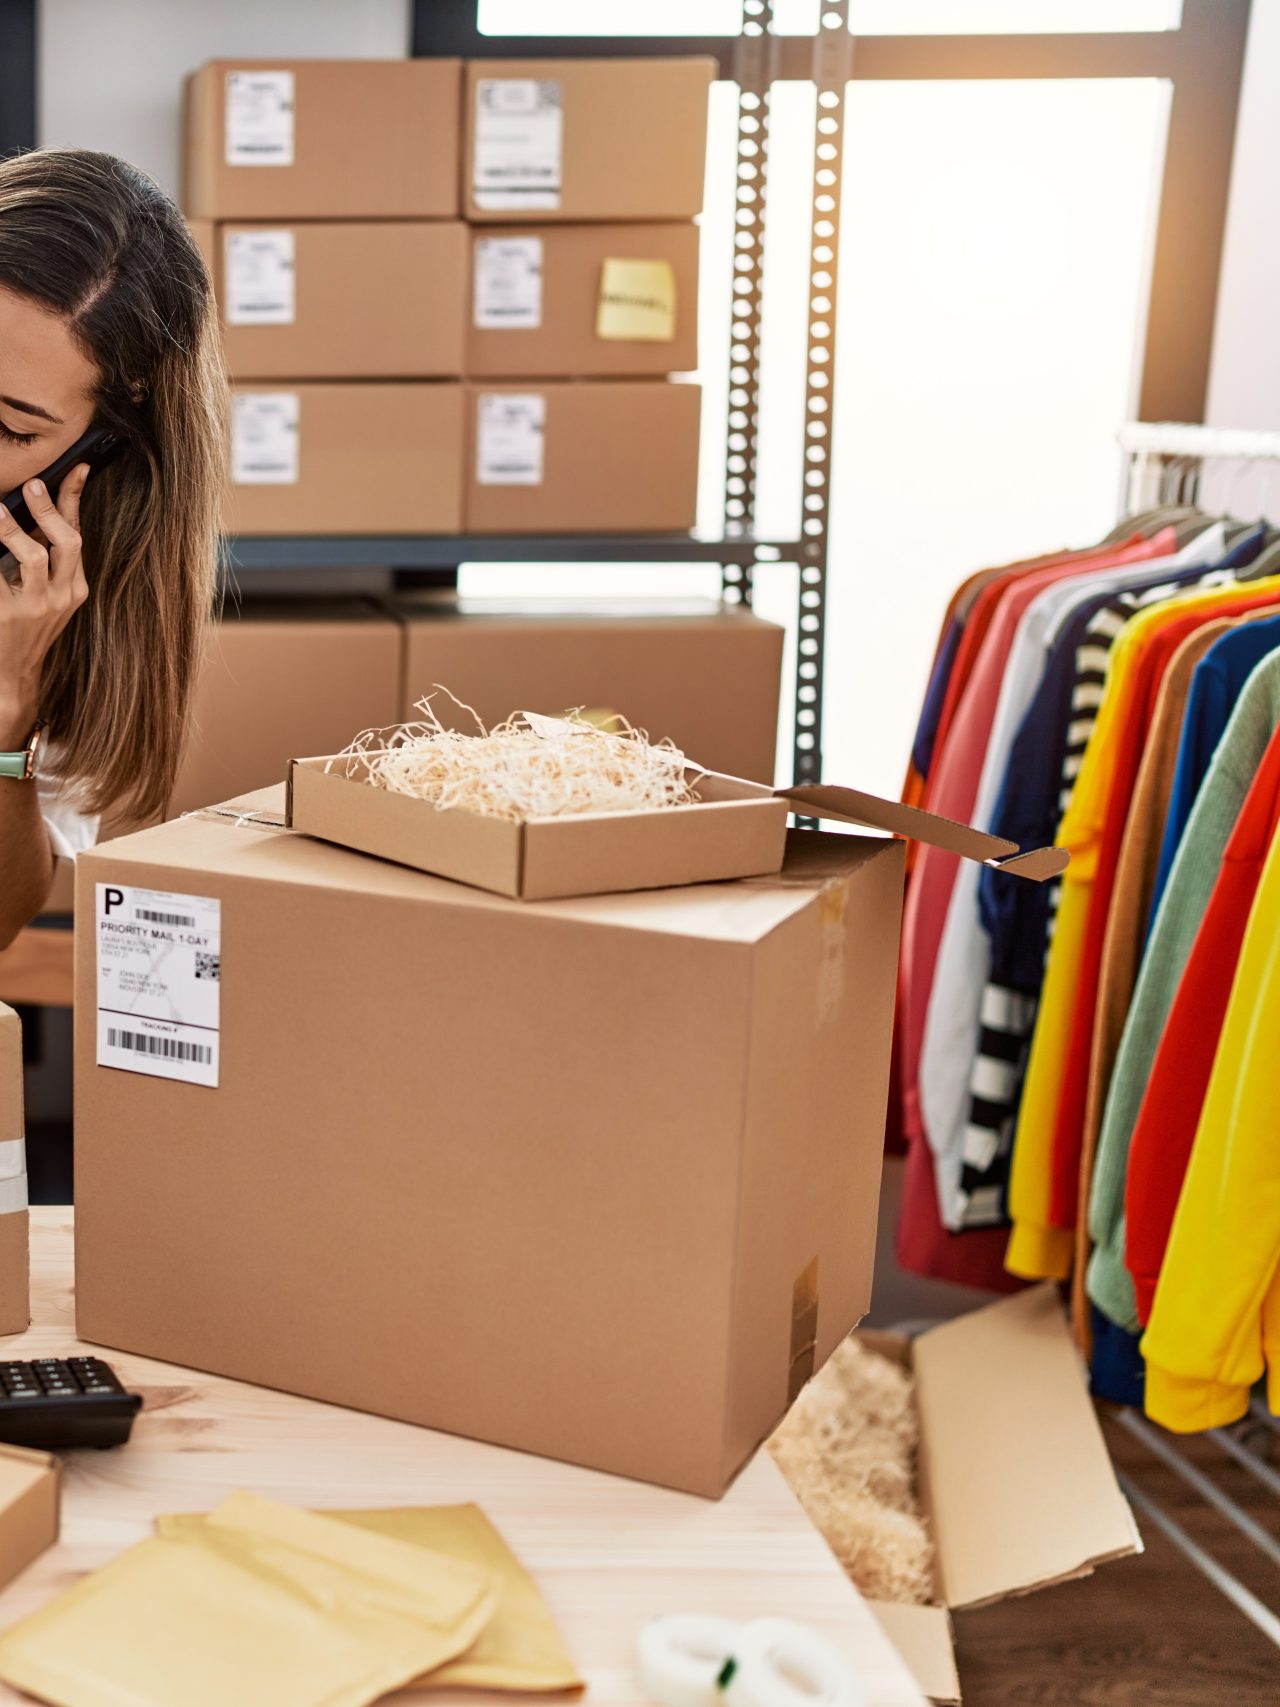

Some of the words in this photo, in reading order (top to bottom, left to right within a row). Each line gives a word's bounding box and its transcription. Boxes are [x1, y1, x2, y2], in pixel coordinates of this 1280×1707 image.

[105, 888, 124, 915] P
[101, 922, 148, 937] PRIORITY
[151, 929, 175, 942] MAIL
[179, 934, 209, 947] 1-DAY
[141, 1022, 174, 1032] TRACKING
